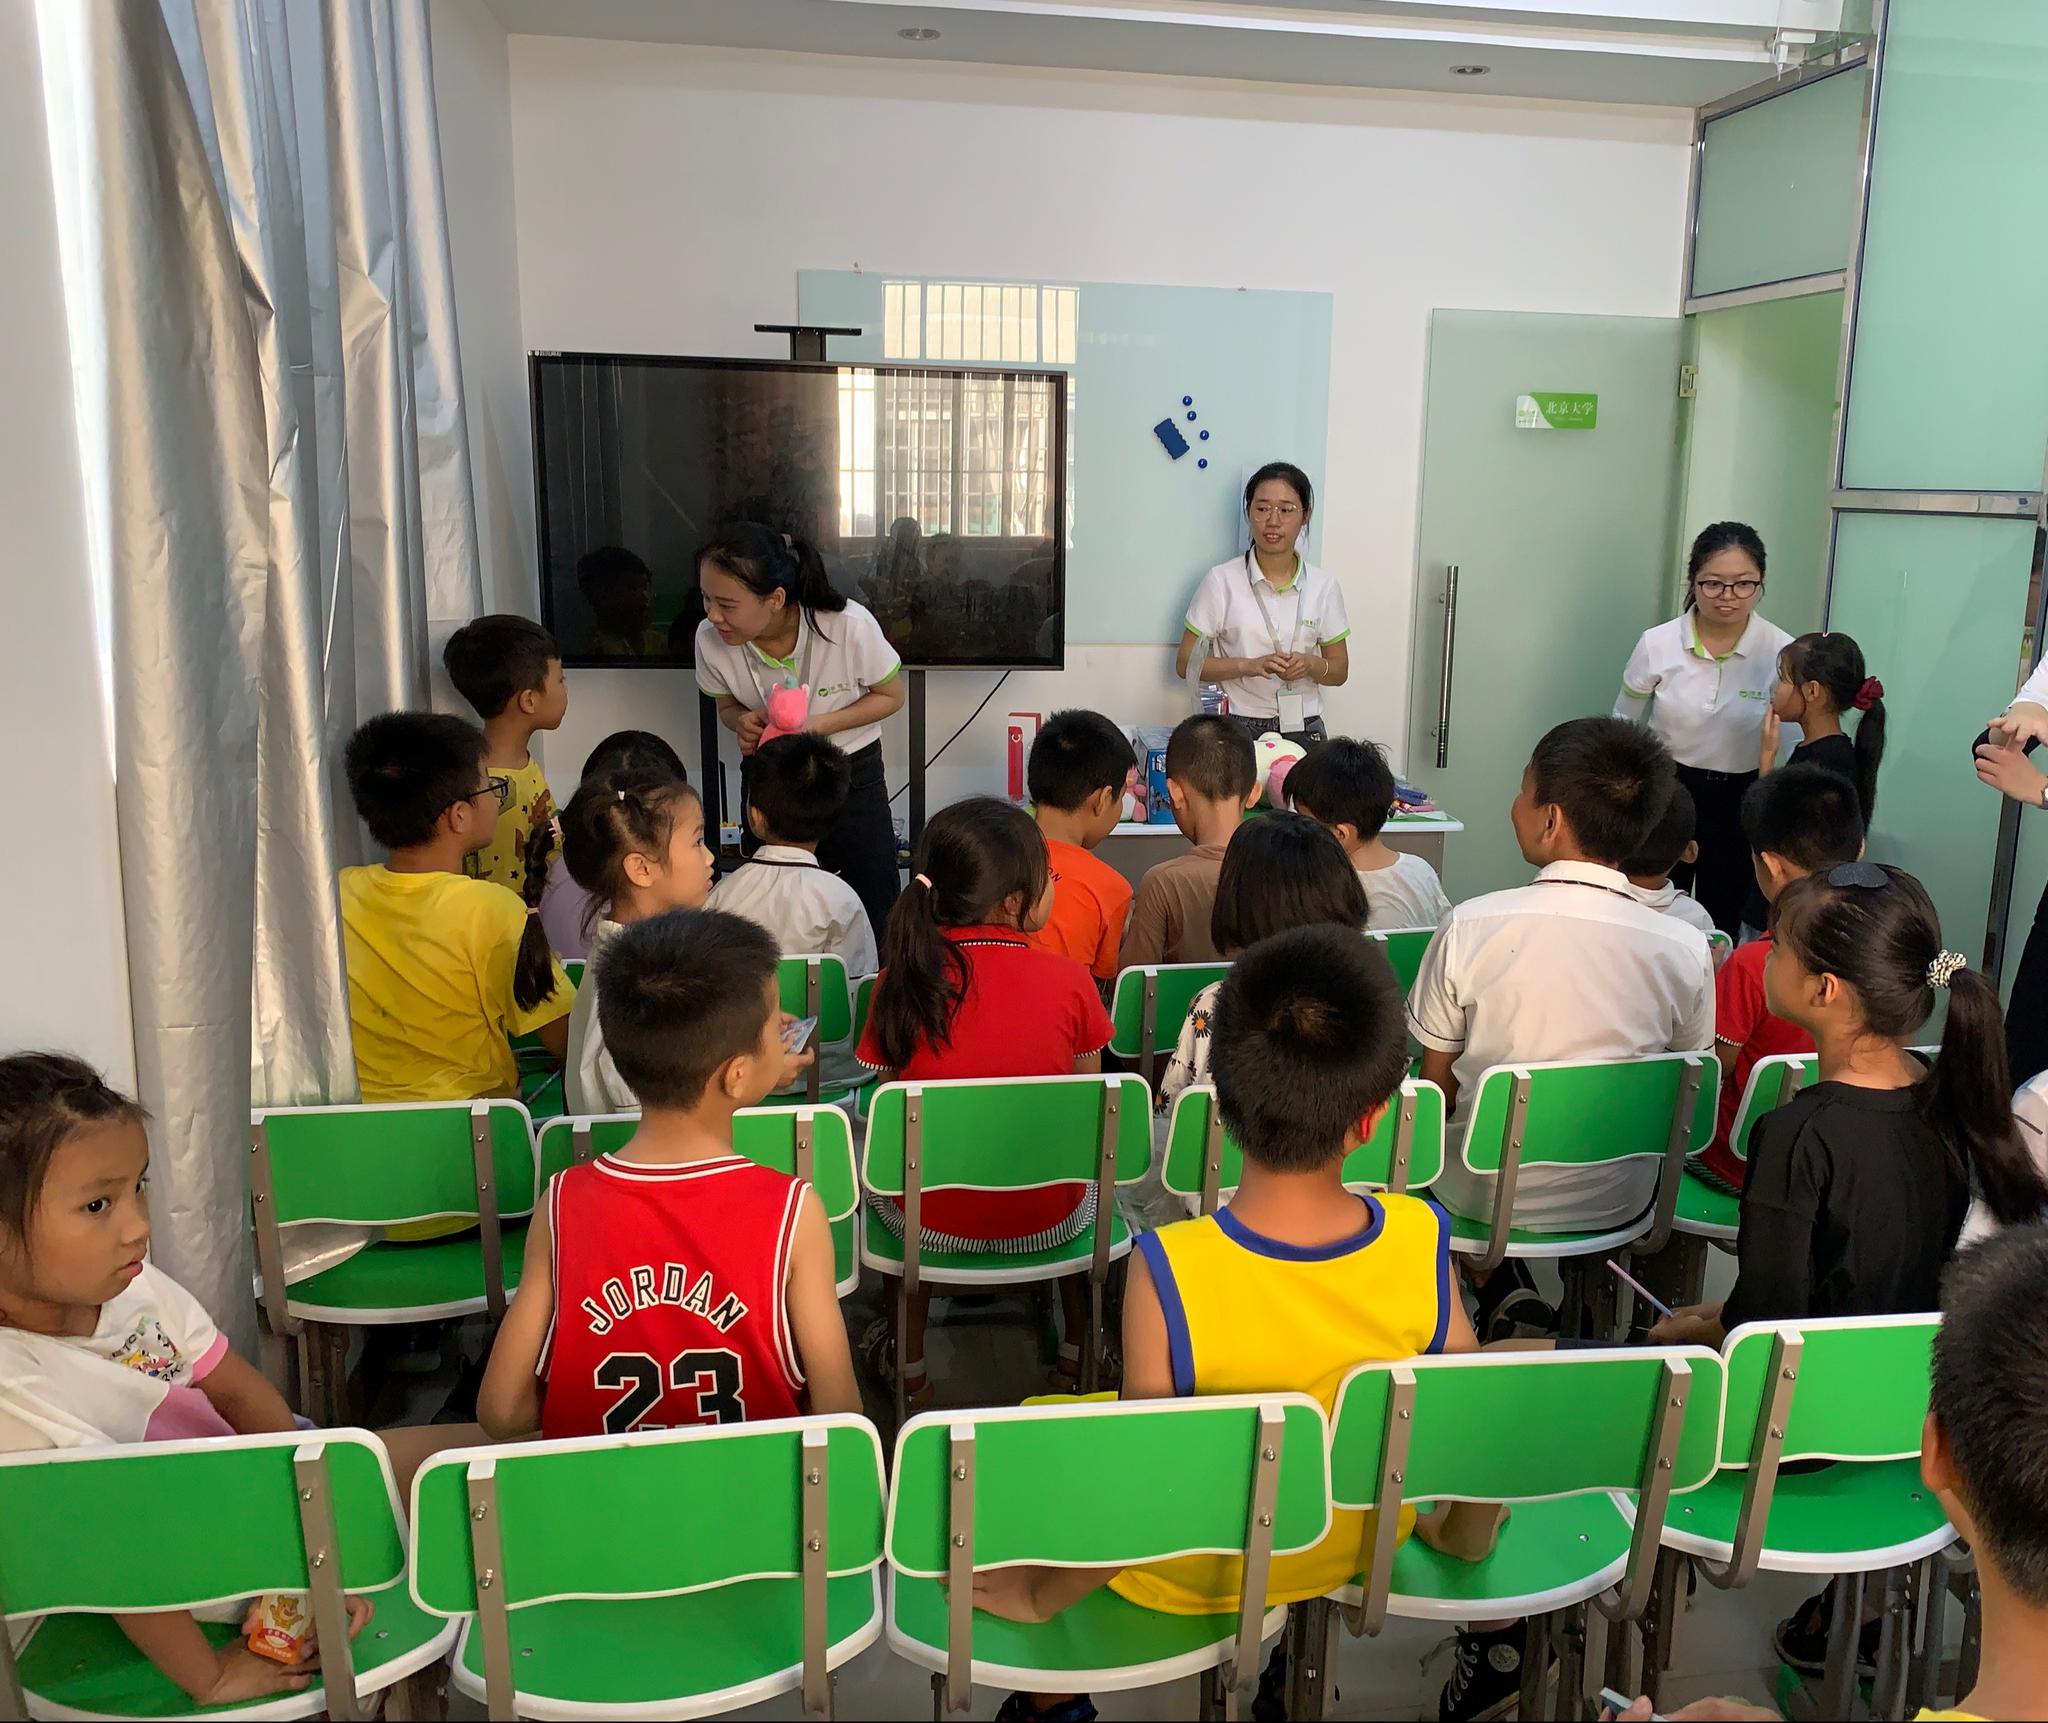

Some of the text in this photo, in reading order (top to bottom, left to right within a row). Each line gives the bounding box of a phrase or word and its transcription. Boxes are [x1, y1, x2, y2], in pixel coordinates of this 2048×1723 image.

[1546, 400, 1594, 415] 北京大学
[581, 1262, 749, 1335] JORDAN
[594, 1347, 747, 1435] 23
